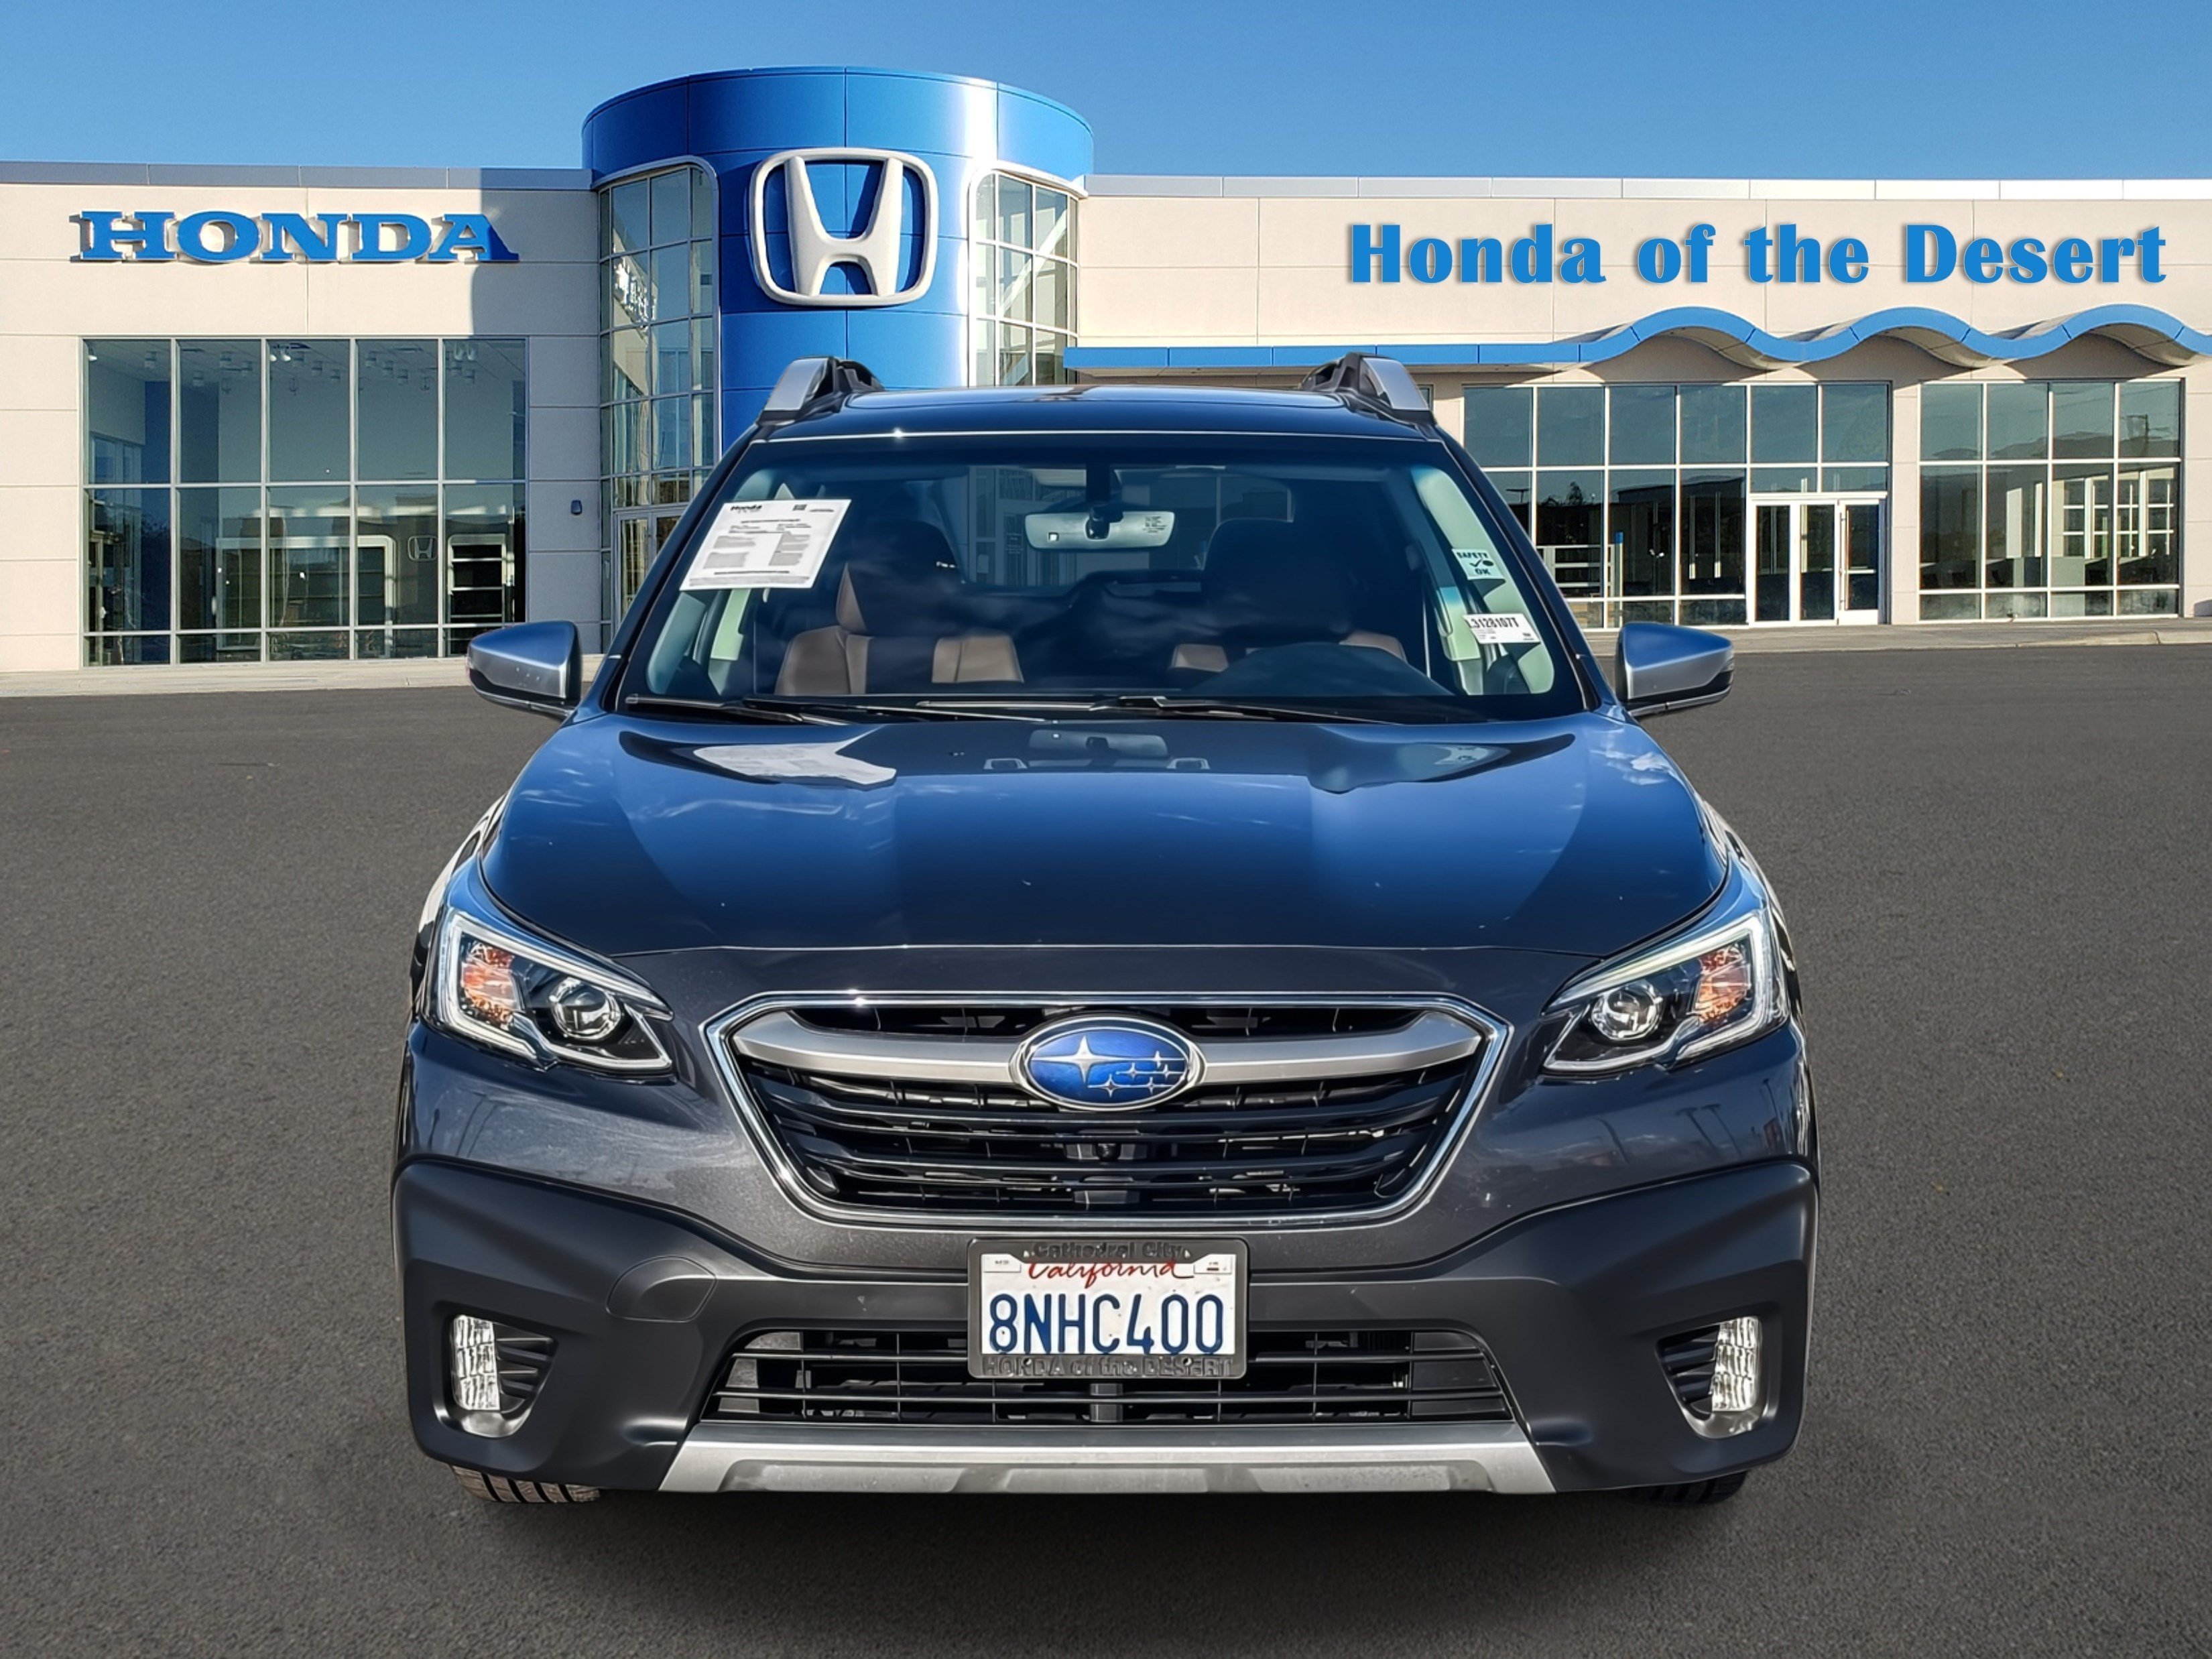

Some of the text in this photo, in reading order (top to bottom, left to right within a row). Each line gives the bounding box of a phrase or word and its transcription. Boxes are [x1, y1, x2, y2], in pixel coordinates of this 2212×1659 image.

[75, 210, 518, 261] HONDA
[1351, 223, 2166, 284] Honda of the Desert
[1033, 1241, 1184, 1258] Cathedral City
[1028, 1259, 1194, 1289] California
[989, 1293, 1224, 1355] 8NHC400
[1070, 1355, 1095, 1376] of
[1097, 1355, 1138, 1376] the
[1141, 1355, 1234, 1377] DESERT
